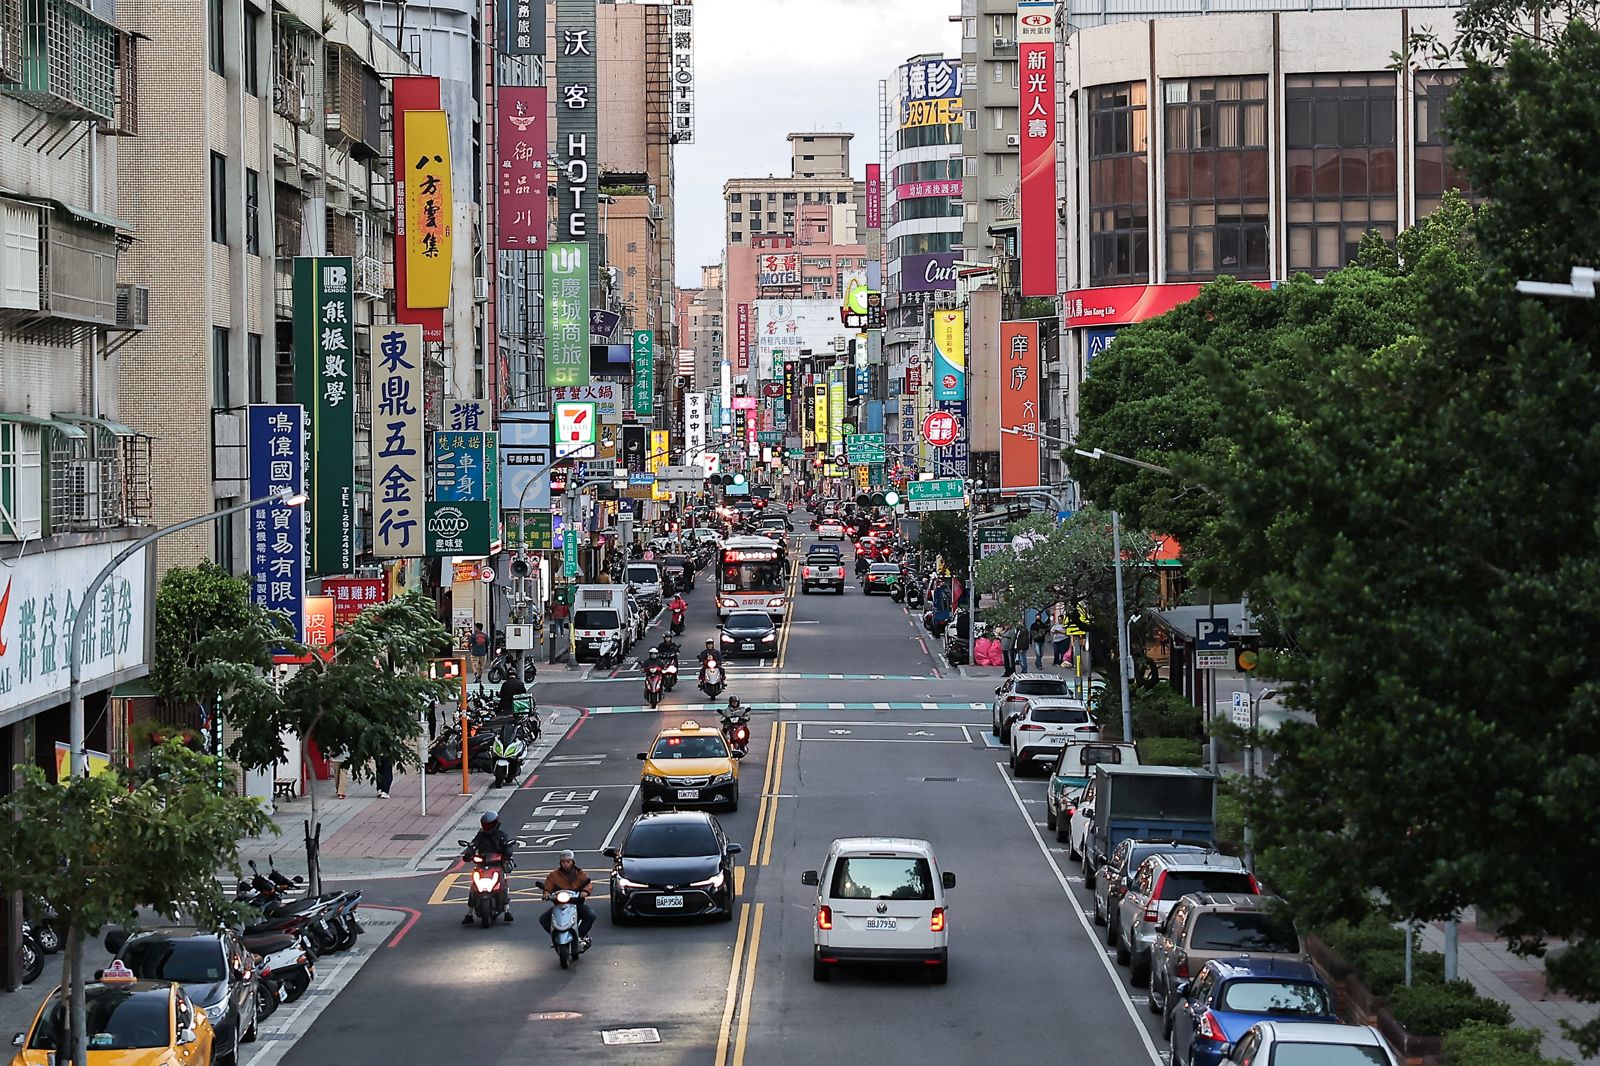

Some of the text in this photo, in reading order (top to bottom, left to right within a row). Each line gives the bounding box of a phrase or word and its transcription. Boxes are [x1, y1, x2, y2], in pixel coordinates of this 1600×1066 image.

[517, 0, 531, 48] 務旅館
[564, 30, 590, 109] 沃客
[901, 61, 963, 101] 德診
[675, 54, 692, 128] HOTEL
[1028, 50, 1048, 138] 新光人壽
[512, 141, 533, 227] 御品川
[567, 134, 588, 242] HOTE
[909, 183, 963, 197] 幼幼產後護理
[416, 155, 442, 258] 八方雲集
[507, 236, 538, 245] 二樓
[761, 272, 799, 285] MOTEL
[561, 278, 582, 364] 慶城商旅
[1084, 306, 1116, 317] Shin Kong Life
[321, 300, 349, 407] 熊振數學
[556, 367, 580, 382] 5F
[929, 418, 953, 430] 台灣
[378, 331, 416, 547] 東鼎五金行
[438, 435, 481, 450] 梵提諾
[508, 455, 544, 463] 平面停車場
[456, 453, 477, 501] 車身
[914, 481, 957, 493] 光興街
[428, 518, 469, 532] MWD
[435, 538, 464, 548] 麥味登
[1198, 621, 1214, 640] P
